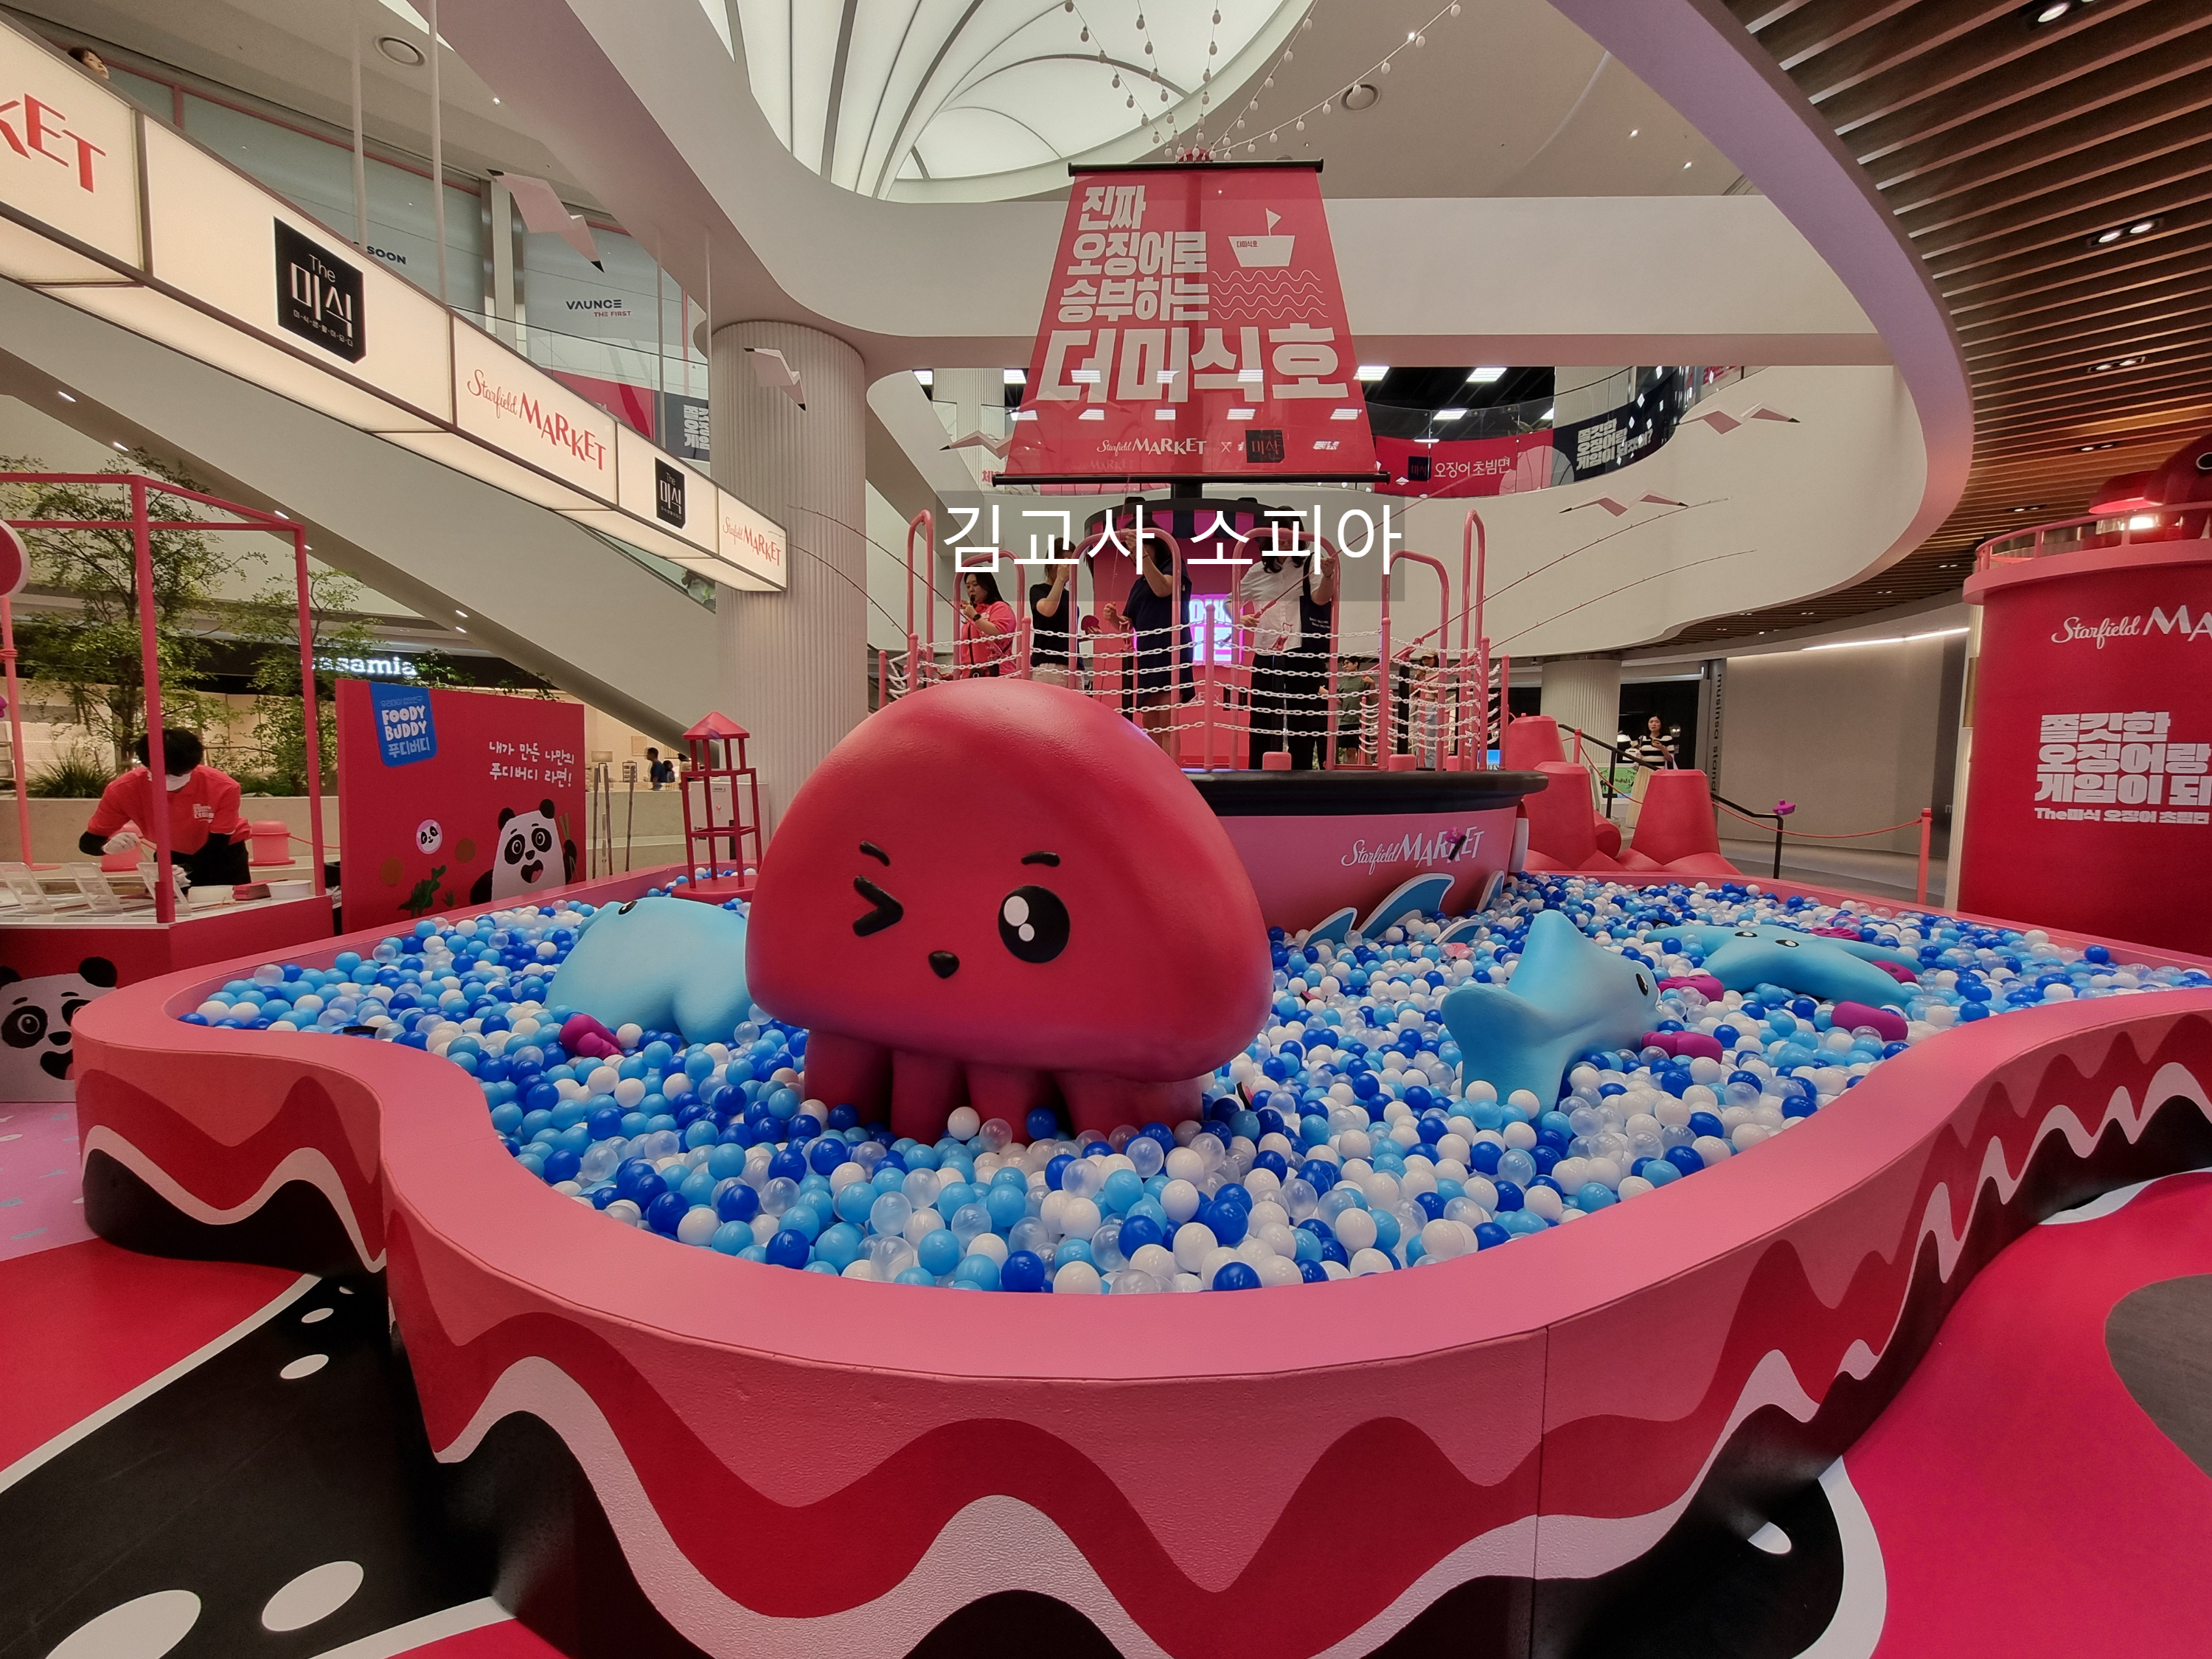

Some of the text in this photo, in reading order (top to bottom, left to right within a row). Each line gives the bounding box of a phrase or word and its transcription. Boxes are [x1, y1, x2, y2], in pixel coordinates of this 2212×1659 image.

[1078, 185, 1146, 231] 진짜
[309, 254, 335, 282] The
[366, 246, 406, 265] SOON
[1067, 231, 1207, 276] 오징어로
[291, 262, 352, 338] 미식
[566, 299, 622, 310] VAUNCE
[1057, 276, 1209, 322] 승부하는
[1036, 322, 1349, 403] 더미식호
[467, 369, 606, 470] Starfield MARKET
[1578, 418, 1617, 443] 쫄깃한
[1096, 439, 1132, 456] Starfield
[1132, 437, 1207, 455] MARKET
[1576, 445, 1615, 470] 게임이
[1577, 428, 1628, 457] 오징어랑
[666, 472, 675, 485] The
[660, 480, 681, 515] 미식
[742, 525, 782, 566] MARKET
[2051, 616, 2140, 649] Starfield
[381, 705, 425, 726] FOODY
[2040, 711, 2171, 742] 쫄깃한
[388, 737, 430, 758] 푸디버디
[1711, 674, 1722, 792] musinsa stand
[489, 741, 574, 766] 내가 만든 나만의
[2037, 742, 2211, 773] 오징어랑
[490, 762, 571, 787] 푸디버디 라면!
[2034, 773, 2212, 806] 게임이 되
[2034, 807, 2101, 821] The미식
[2104, 810, 2157, 823] 오징어
[1340, 839, 1400, 875] Starfield
